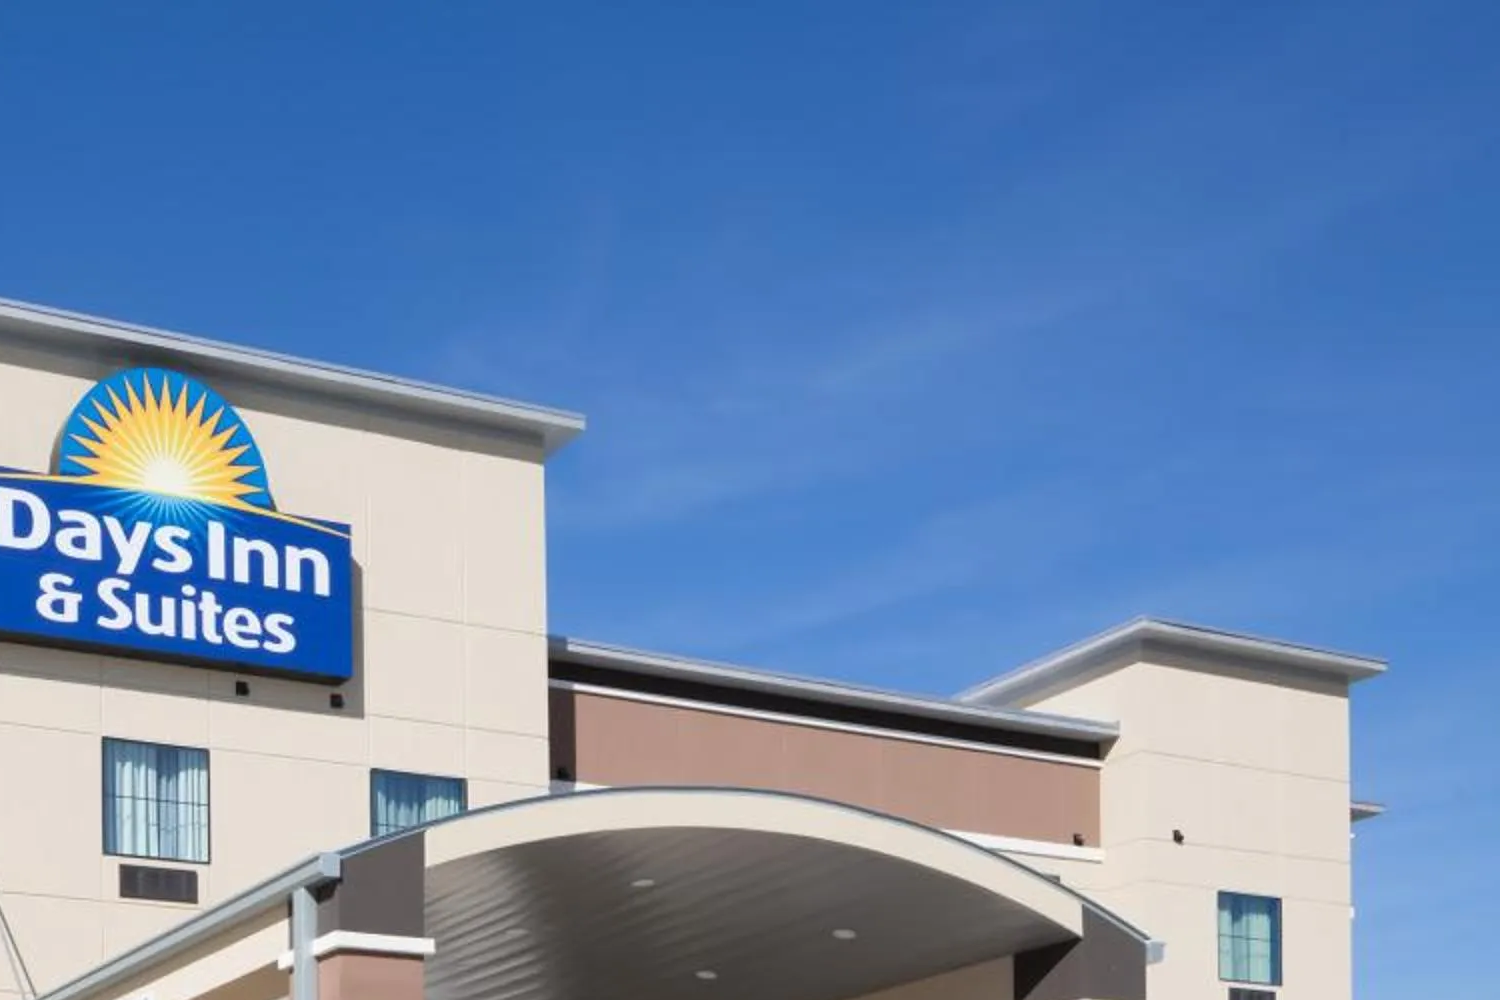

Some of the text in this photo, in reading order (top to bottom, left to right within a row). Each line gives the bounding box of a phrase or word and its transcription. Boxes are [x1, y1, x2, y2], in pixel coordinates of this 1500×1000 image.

[207, 521, 330, 597] Inn
[35, 572, 296, 654] & Suites
